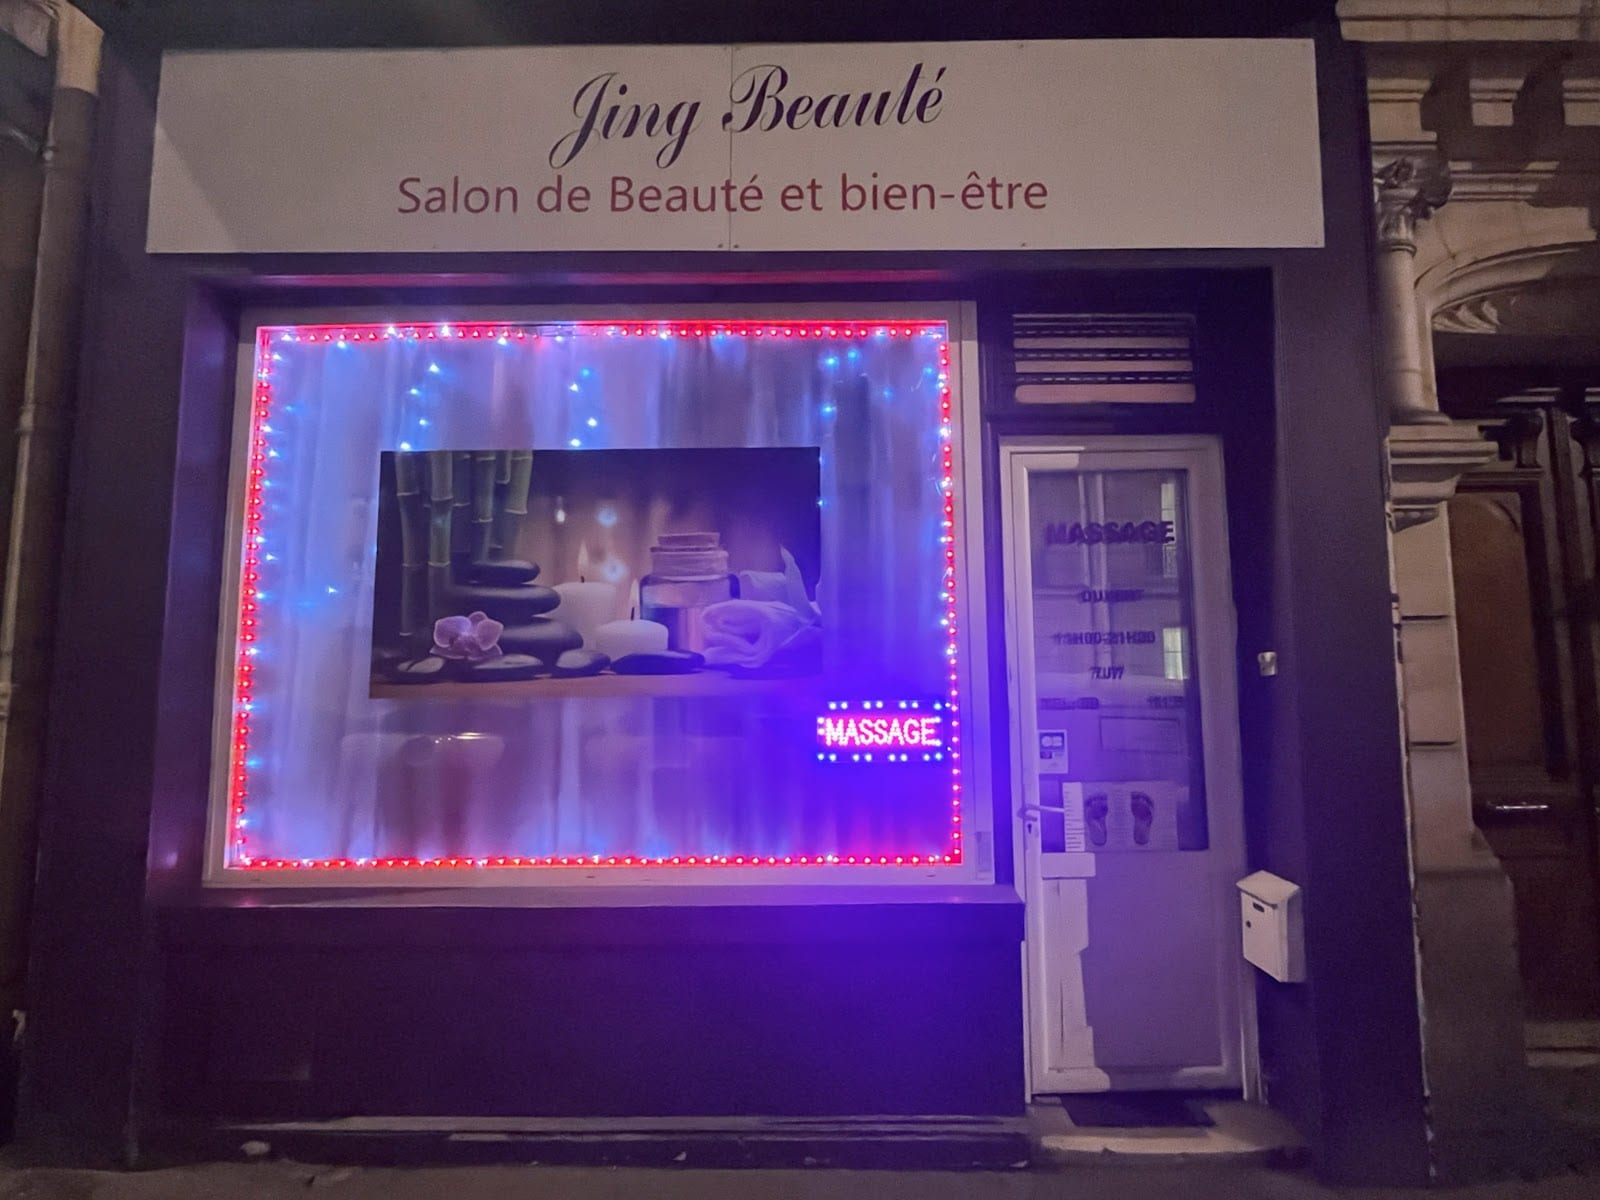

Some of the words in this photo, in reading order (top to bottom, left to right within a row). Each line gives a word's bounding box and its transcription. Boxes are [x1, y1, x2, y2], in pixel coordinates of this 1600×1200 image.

[549, 71, 702, 169] Jing
[722, 62, 946, 133] Beauté
[398, 176, 518, 214] Salon
[537, 174, 591, 213] de
[609, 174, 764, 213] Beauté
[780, 177, 824, 211] et
[840, 170, 1049, 211] bien-être
[1046, 521, 1176, 545] MASSAGE
[825, 717, 941, 746] MASSAGE
